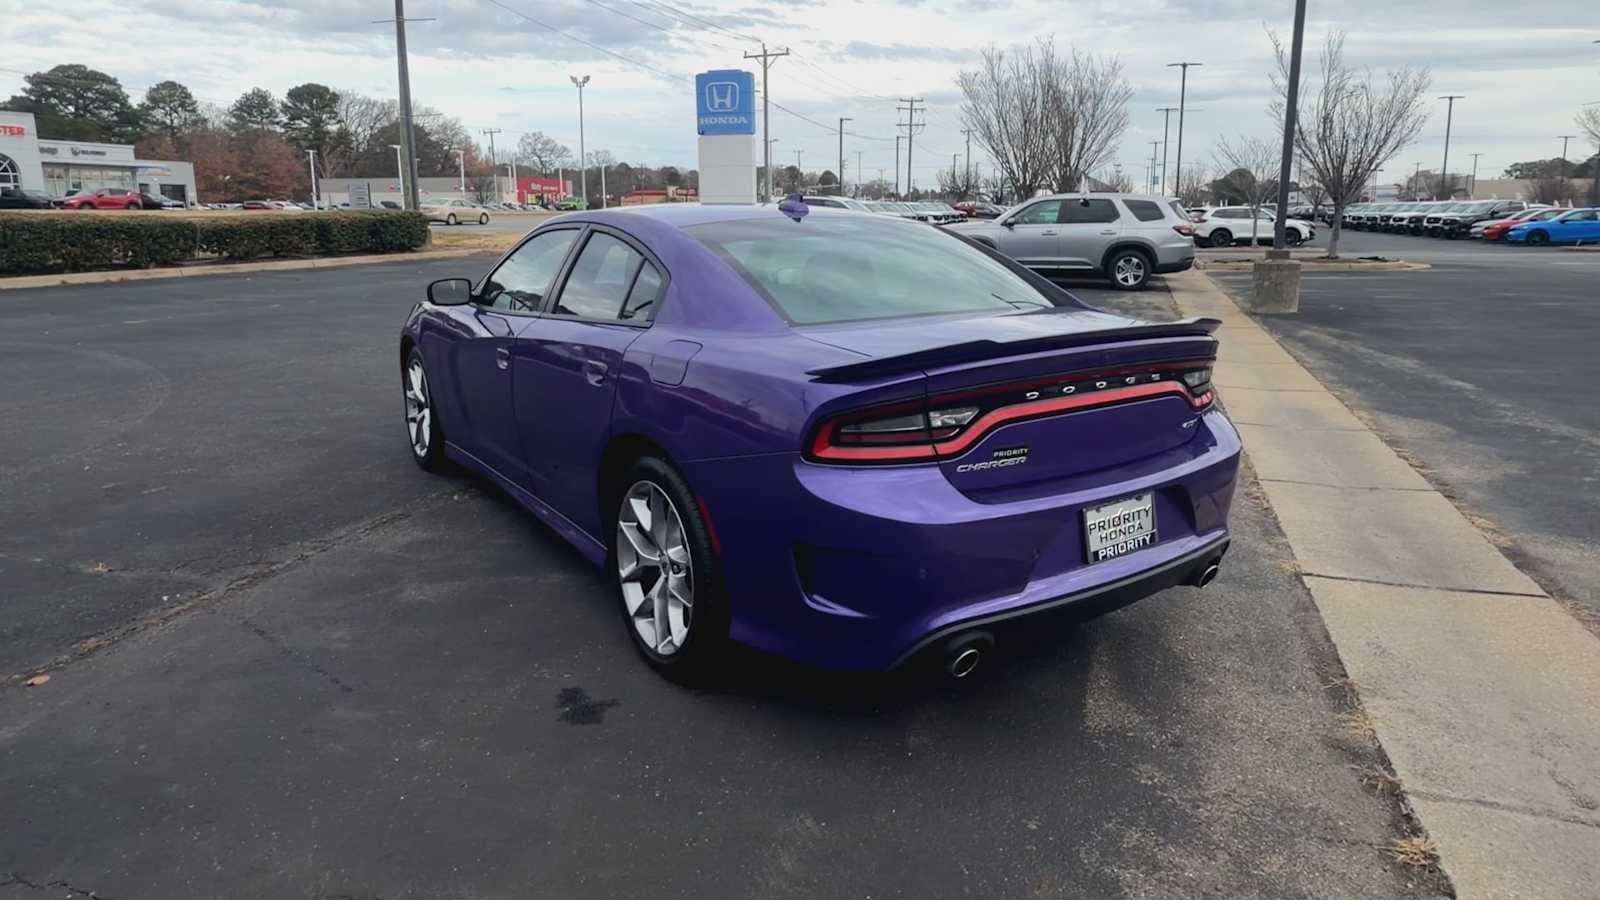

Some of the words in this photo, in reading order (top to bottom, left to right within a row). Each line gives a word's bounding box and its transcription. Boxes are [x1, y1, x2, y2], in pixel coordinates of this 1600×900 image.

[699, 116, 747, 125] HONDA
[1025, 373, 1161, 400] DODGE
[993, 447, 1029, 457] PRIORITY
[956, 456, 1027, 473] CHARGER
[1088, 505, 1151, 535] PRIORITY
[1099, 521, 1143, 543] HONDA
[1098, 535, 1151, 560] PRIORITY
